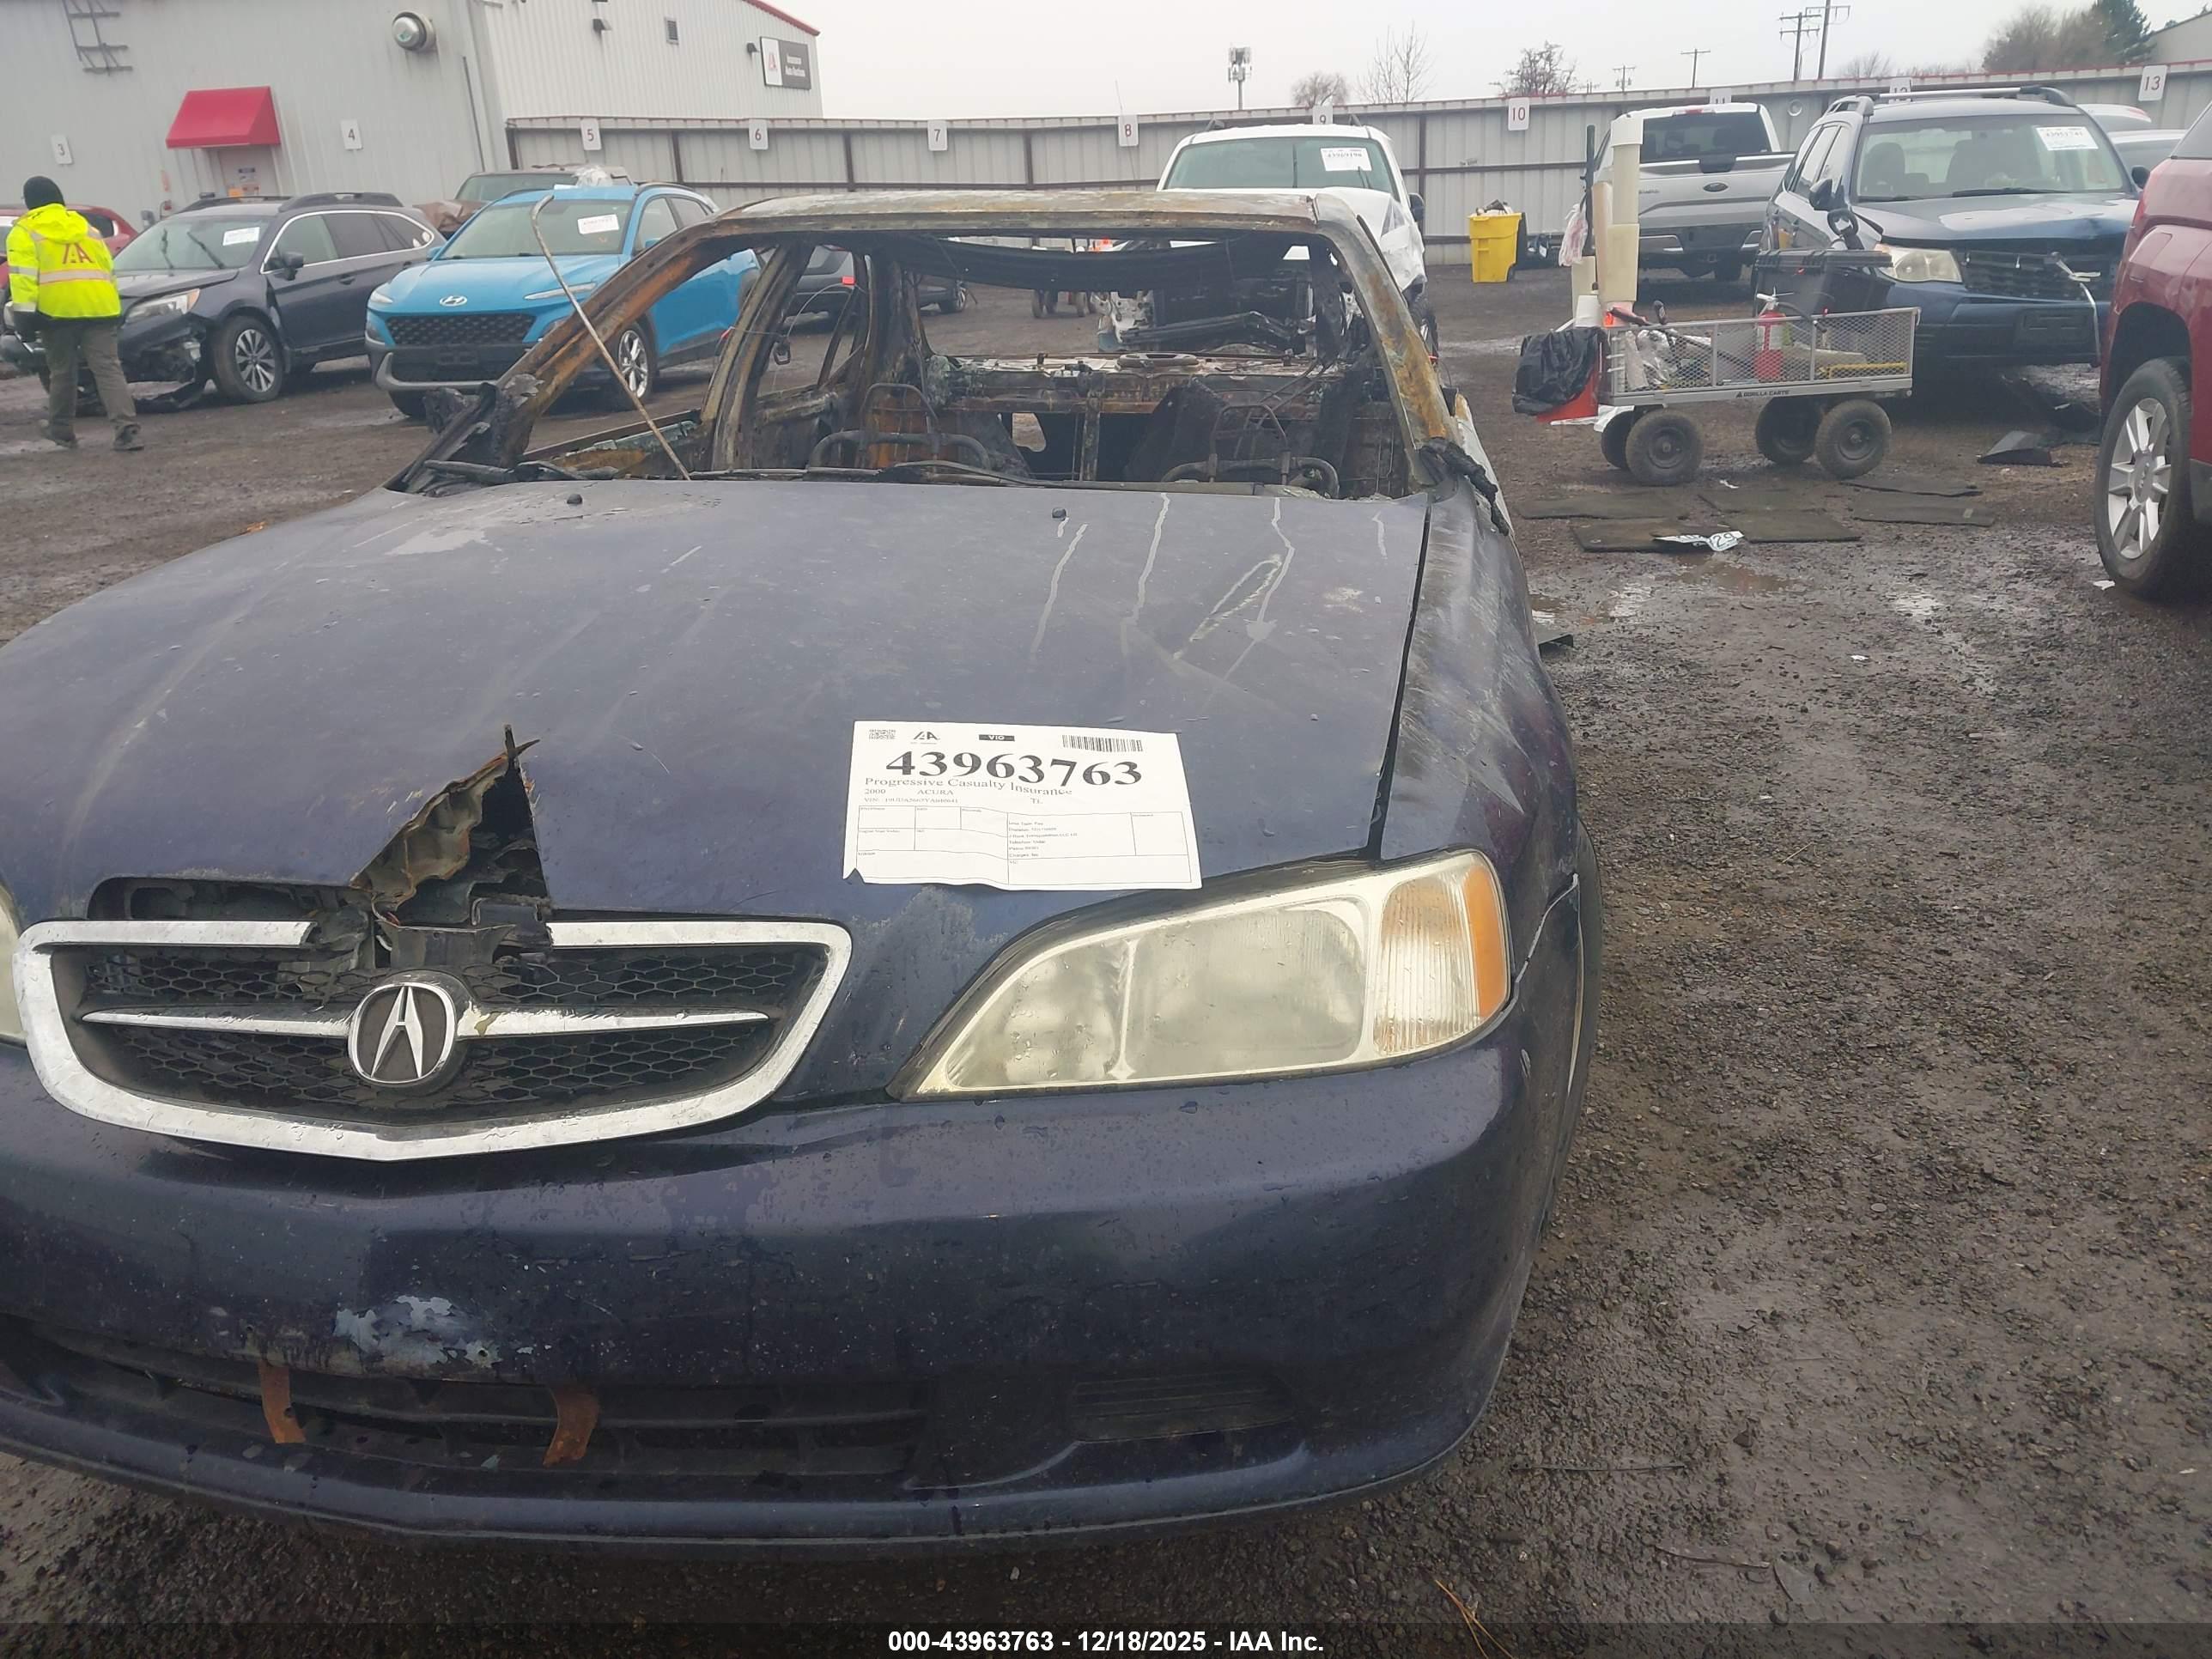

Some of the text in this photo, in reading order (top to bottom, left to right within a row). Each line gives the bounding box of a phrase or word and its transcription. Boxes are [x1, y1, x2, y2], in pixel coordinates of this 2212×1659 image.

[2144, 76, 2161, 91] 13
[1319, 114, 1327, 125] 9
[1512, 106, 1526, 122] 10
[348, 128, 356, 142] 4
[586, 128, 594, 142] 5
[755, 128, 763, 142] 6
[933, 128, 941, 142] 7
[1124, 124, 1132, 138] 8
[58, 143, 65, 156] 3
[886, 750, 1142, 787] 43963763
[865, 777, 1073, 795] Progressive Casualty Insurance
